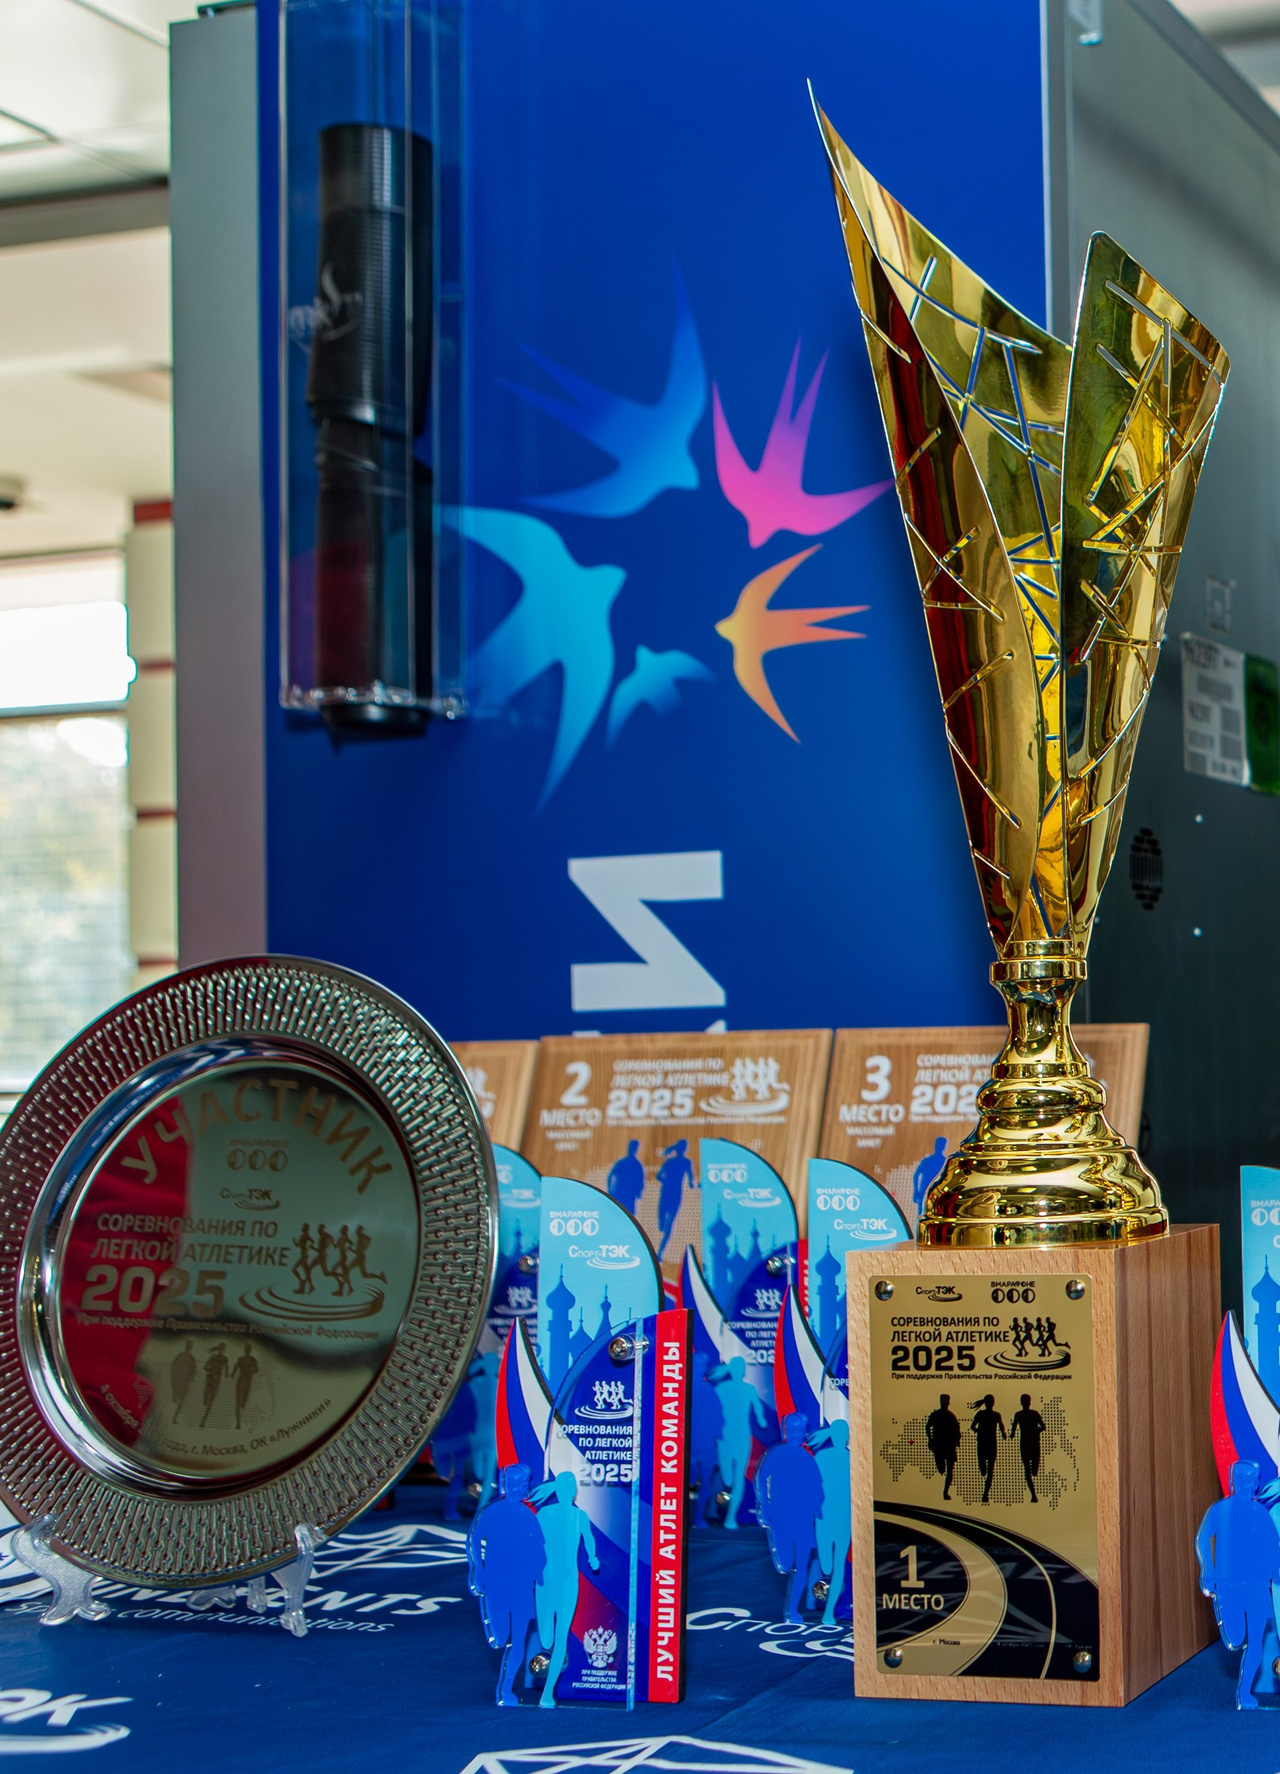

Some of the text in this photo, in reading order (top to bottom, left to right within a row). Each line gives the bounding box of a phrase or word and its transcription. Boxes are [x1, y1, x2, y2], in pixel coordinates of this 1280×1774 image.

[916, 1054, 994, 1068] СОРЕВНОВАН
[560, 1061, 592, 1107] 2
[860, 1054, 893, 1102] 3
[915, 1065, 991, 1084] ЛЕГКОЙ АТ
[606, 1087, 695, 1118] 2025
[910, 1084, 978, 1114] 202
[839, 1103, 905, 1123] МЕСТО
[120, 1078, 392, 1195] УЧАСТНИК
[97, 1214, 278, 1238] СОРЕВНОВАНИЯ ПО
[90, 1237, 291, 1267] ЛЕГКОЙ АТЛЕТИКЕ
[81, 1265, 227, 1318] 2025
[890, 1316, 1000, 1327] СОРЕВНОВАНИЯ ПО
[891, 1328, 1010, 1343] ЛЕГКОЙ АТЛЕТИКЕ
[746, 1349, 776, 1364] 202
[891, 1345, 976, 1372] 2025
[906, 1373, 943, 1381] поддержке
[994, 1372, 1032, 1380] Российской
[1034, 1373, 1072, 1381] Федерации
[559, 1425, 633, 1435] СОРЕВНОВАНИЯ
[579, 1437, 633, 1448] ПО ЛЕГКОЙ
[584, 1451, 633, 1461] АТЛЕТИКЕ
[581, 1464, 633, 1482] 2025
[656, 1341, 683, 1682] ЛУЧШИЙ АТЛЕТ КОМАНДЫ
[899, 1545, 925, 1588] 1
[882, 1593, 945, 1610] МЕСТО
[117, 1607, 395, 1632] communictions
